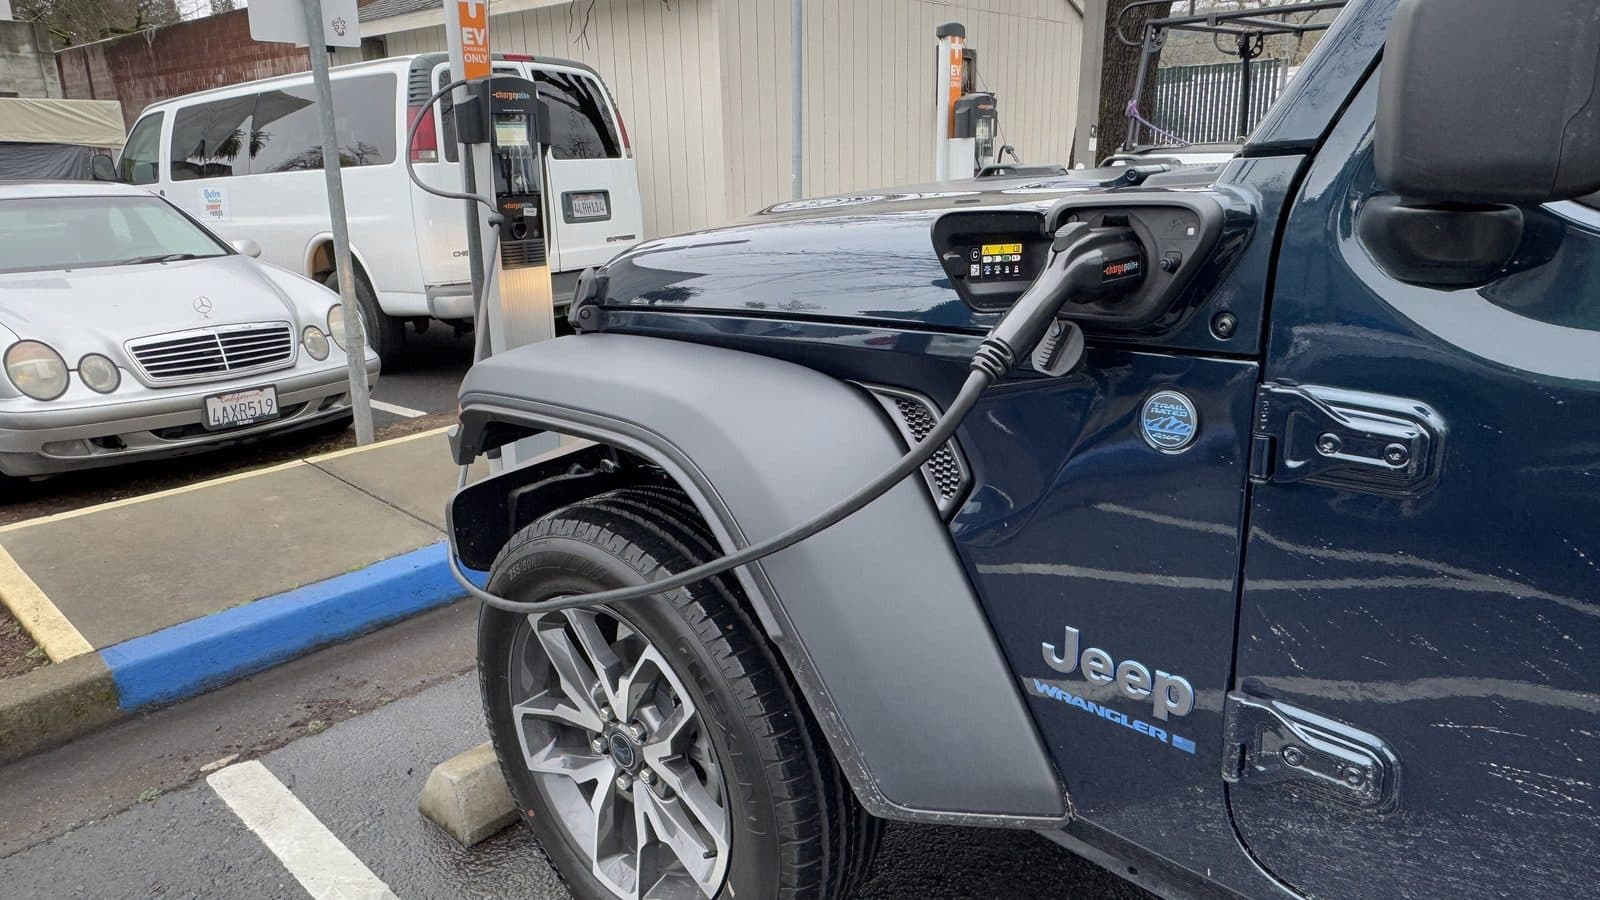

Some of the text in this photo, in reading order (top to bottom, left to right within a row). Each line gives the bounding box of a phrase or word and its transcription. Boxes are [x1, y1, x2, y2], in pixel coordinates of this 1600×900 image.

[461, 26, 486, 46] EV
[463, 53, 488, 64] ONLY
[212, 398, 274, 426] 4AXR519
[1150, 407, 1188, 417] RATED
[1151, 401, 1185, 411] TRAIL
[1041, 625, 1195, 722] Jeep
[1032, 678, 1169, 744] WRANGLER
